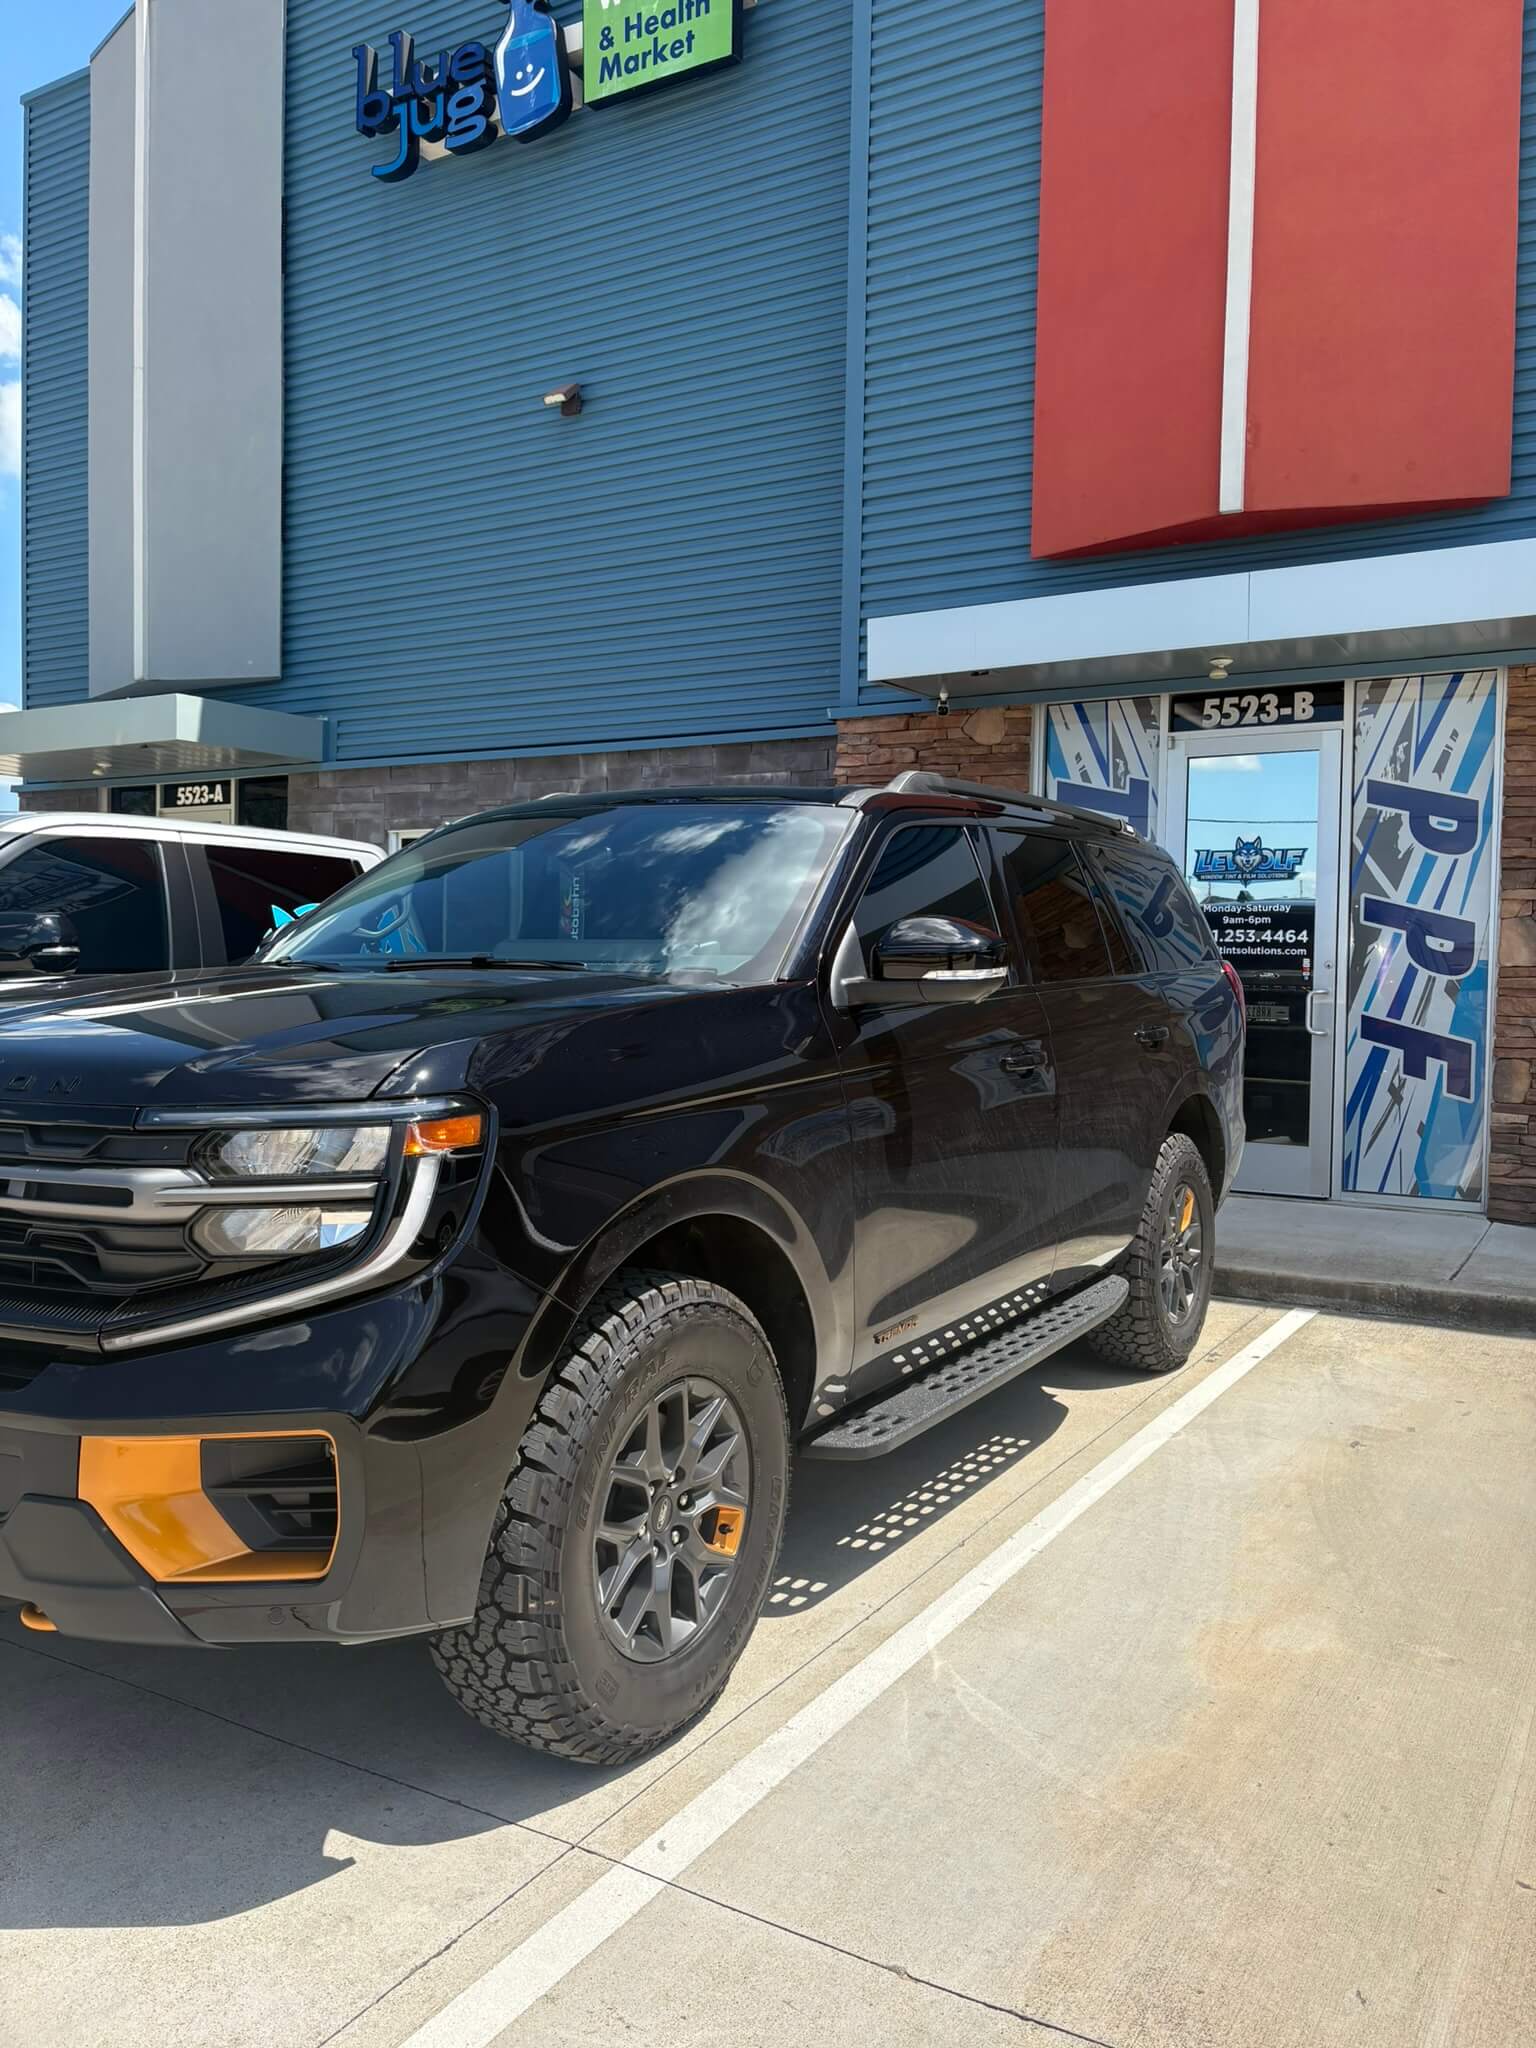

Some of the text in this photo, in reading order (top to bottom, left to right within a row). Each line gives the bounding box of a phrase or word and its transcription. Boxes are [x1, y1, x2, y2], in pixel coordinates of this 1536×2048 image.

[599, 0, 711, 51] & Health
[598, 29, 696, 85] Market
[352, 30, 488, 132] blue
[372, 79, 491, 179] jug
[1201, 690, 1315, 729] 5523-B
[176, 783, 224, 806] 5523-A
[570, 876, 580, 941] utobahn
[1203, 903, 1292, 914] Monday-Saturday
[1222, 915, 1272, 926] 9am-6pm
[1211, 929, 1309, 943] 1.253.4464
